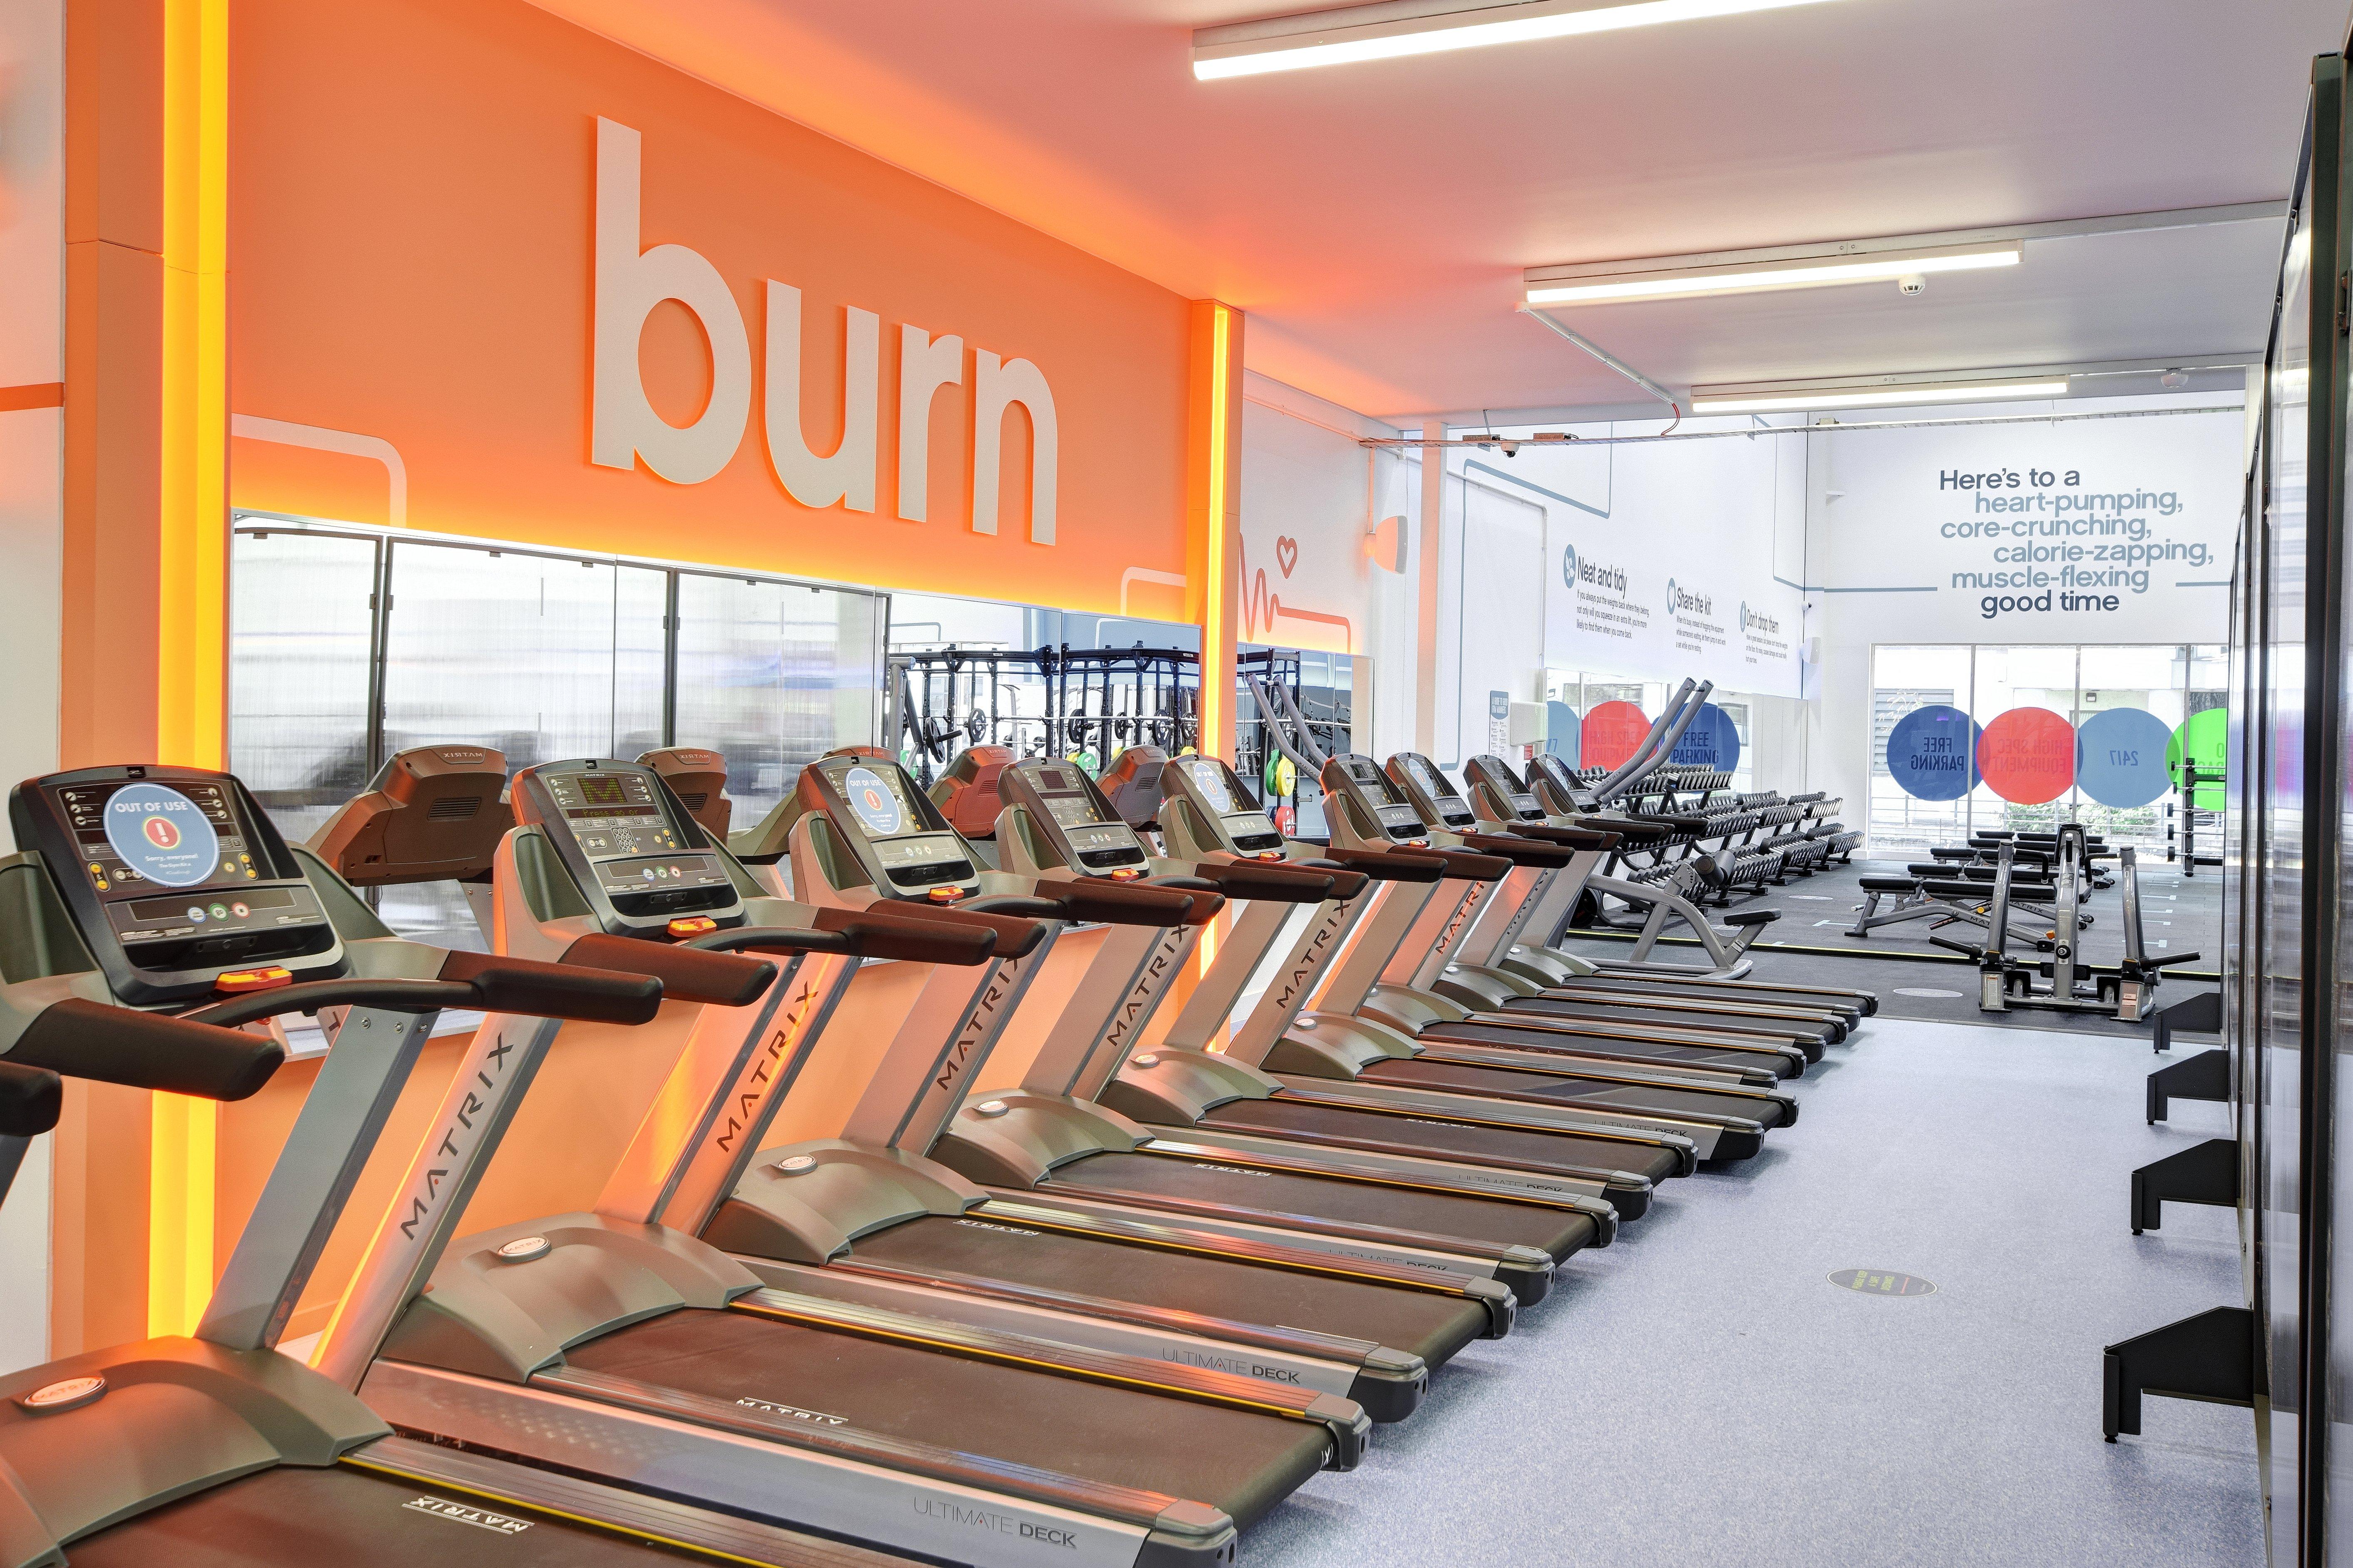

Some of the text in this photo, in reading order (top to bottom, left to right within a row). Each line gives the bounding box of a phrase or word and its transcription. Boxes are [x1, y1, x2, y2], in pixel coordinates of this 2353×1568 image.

[592, 115, 1058, 547] burn
[1940, 468, 2080, 490] Here’s to a
[1975, 488, 2184, 517] heart-pumping,
[1940, 514, 2151, 542] core-crunching,
[1993, 539, 2214, 567] calorie-zapping,
[1578, 556, 1627, 599] Neat and tidy
[1952, 565, 2149, 594] muscle-flexing
[1586, 591, 1596, 604] always
[1607, 598, 1618, 609] weights
[1677, 587, 1693, 611] Share
[1980, 590, 2120, 619] good time
[1585, 622, 1588, 630] to
[1601, 612, 1612, 621] squeeze
[1613, 612, 1616, 621] in
[1758, 612, 1768, 636] drop
[1769, 615, 1778, 634] them
[1683, 732, 1709, 747] FREE
[1673, 749, 1719, 764] PARKING
[1601, 771, 1622, 787] MATRIX
[115, 801, 188, 812] OUT OF USE
[1435, 881, 1484, 955] MATRI
[1276, 900, 1351, 1009] MATRIX
[1106, 925, 1190, 1047] MATRIX
[717, 981, 819, 1153] MATRIX
[400, 1031, 514, 1240] MATRIX
[956, 1220, 1040, 1237] MATRIX
[1163, 1347, 1300, 1384] ULTIMATE DECK
[410, 1498, 528, 1532] MATRIX
[914, 1496, 1077, 1548] ULTIMATE DECK
